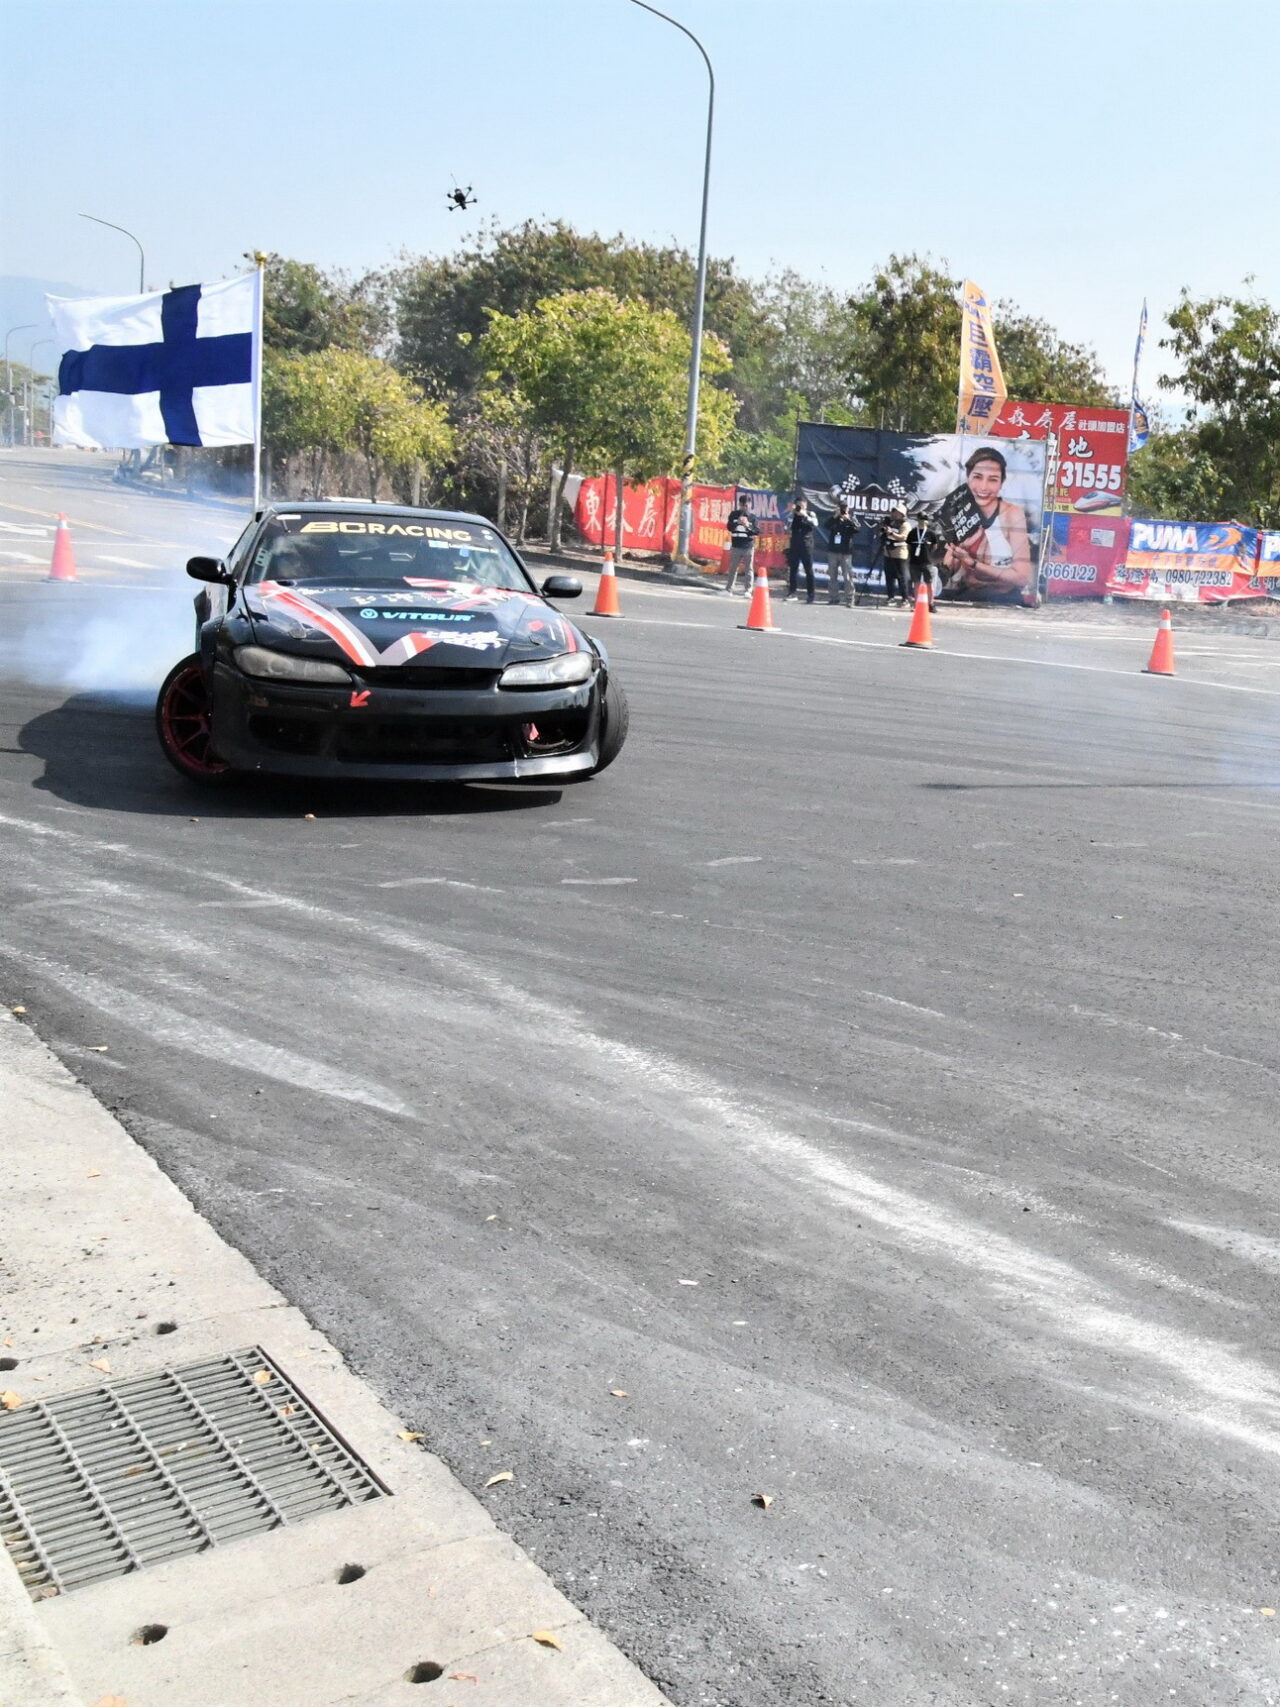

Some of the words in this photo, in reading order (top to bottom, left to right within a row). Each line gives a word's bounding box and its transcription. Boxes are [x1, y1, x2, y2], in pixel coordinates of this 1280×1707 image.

[994, 405, 1077, 431] 森房屋
[1132, 523, 1200, 551] PUMA
[382, 611, 473, 623] VITOUR
